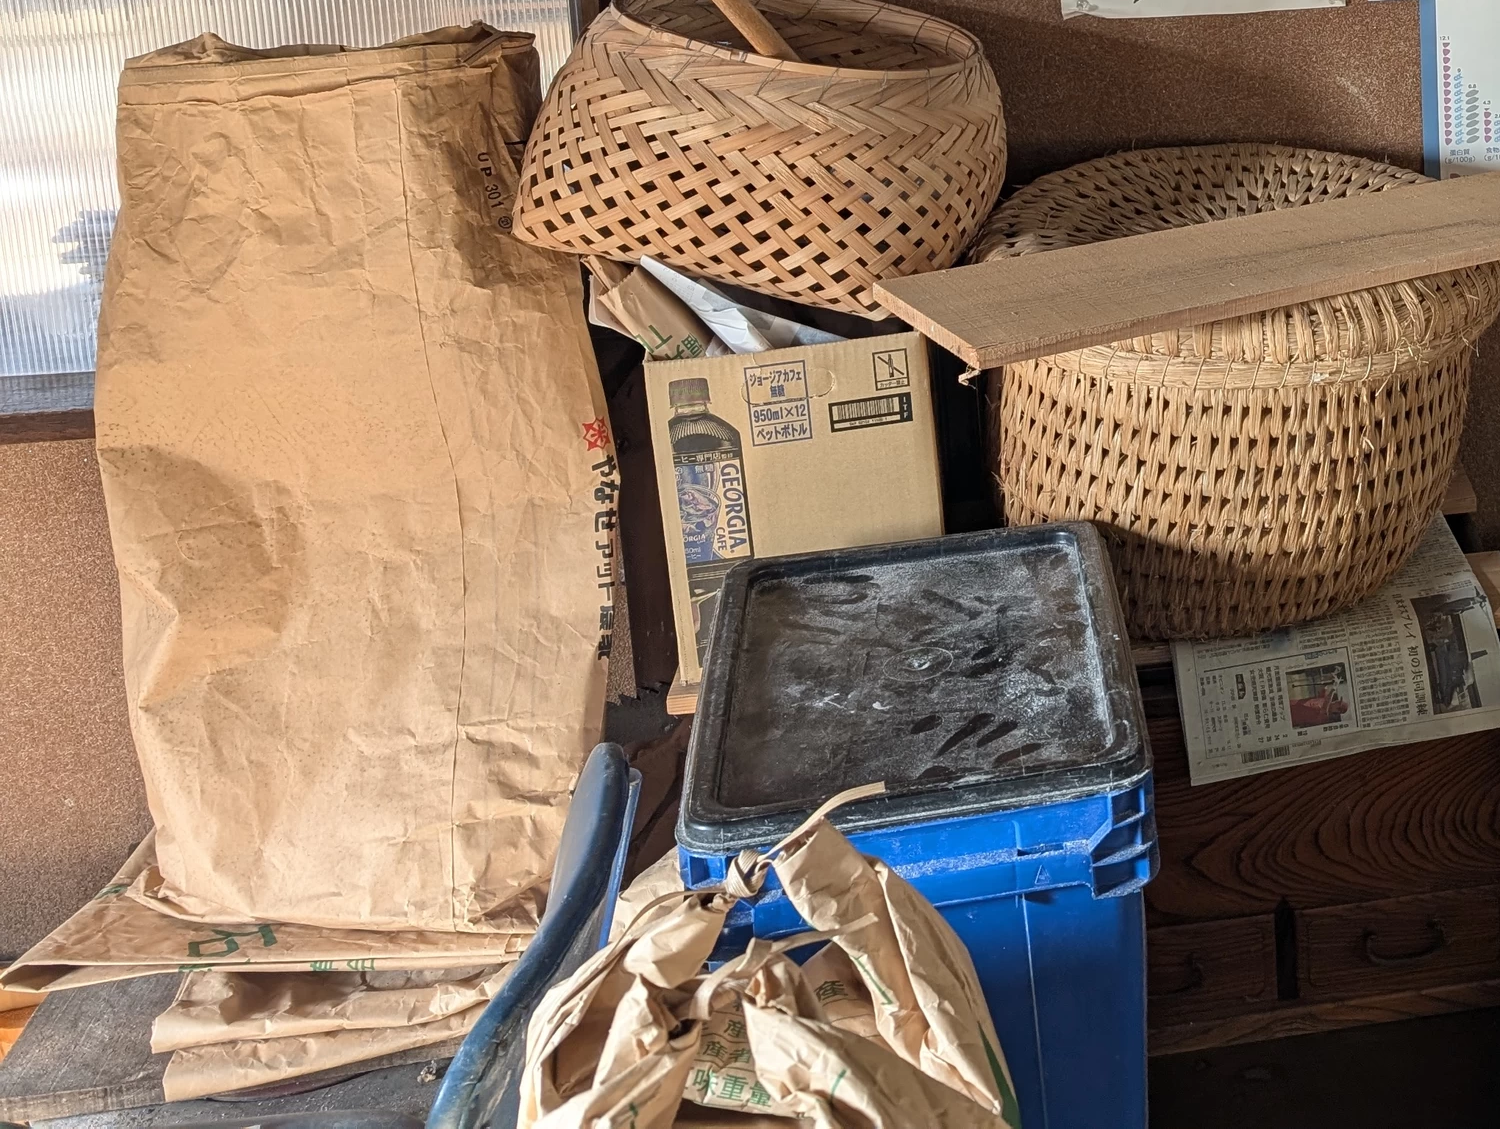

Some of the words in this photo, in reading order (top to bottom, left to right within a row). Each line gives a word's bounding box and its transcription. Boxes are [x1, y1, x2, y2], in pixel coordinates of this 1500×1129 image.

[1444, 156, 1475, 164] (g/100g)
[485, 184, 504, 208] 301
[749, 369, 803, 388] ジョージアカフェ
[769, 385, 786, 399] 無糖
[756, 423, 808, 441] ペットボトル
[720, 463, 748, 554] GEORGIA
[715, 526, 728, 552] CAFE
[1407, 645, 1430, 716] 初の共同訓練
